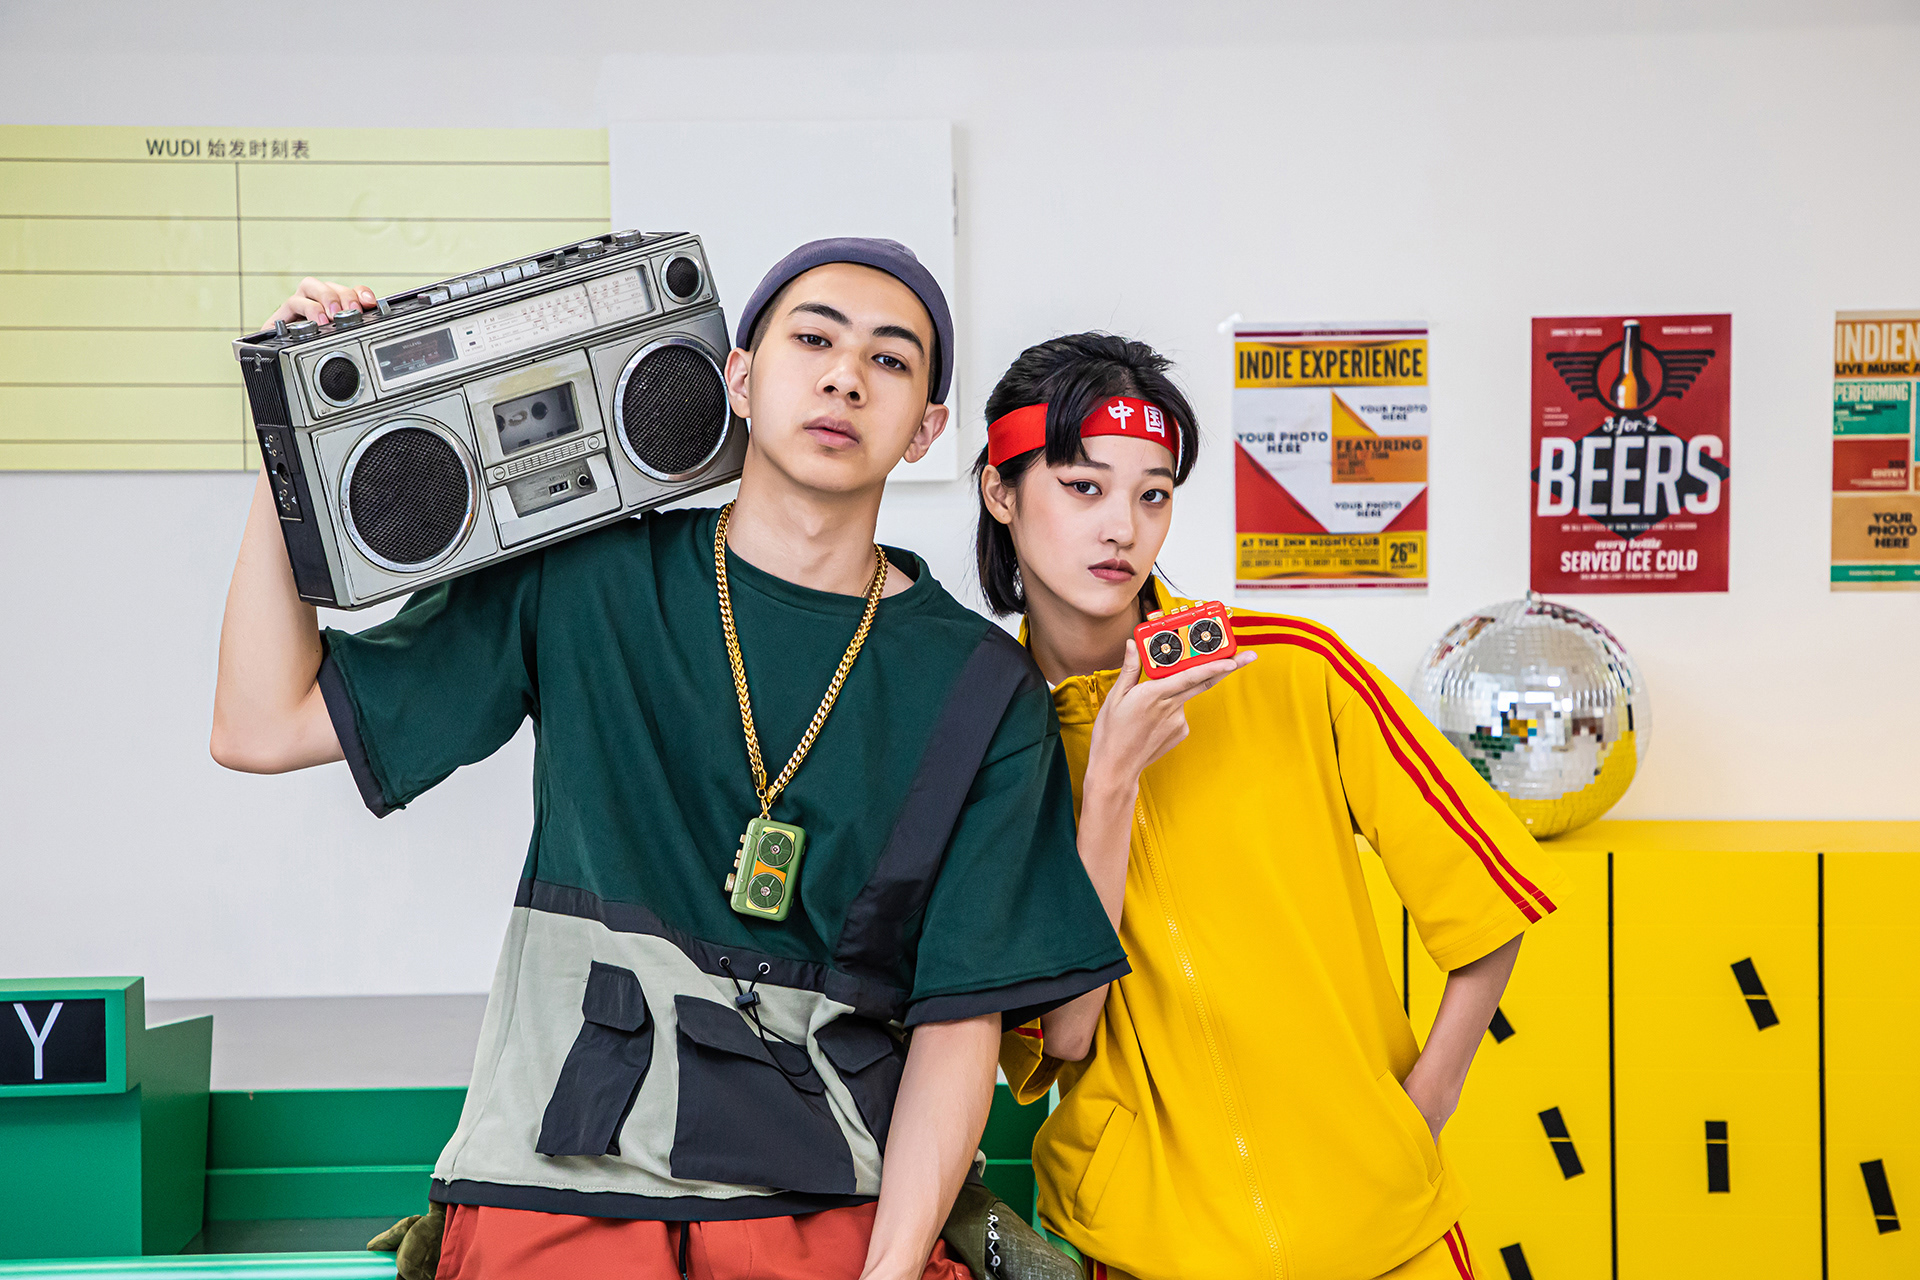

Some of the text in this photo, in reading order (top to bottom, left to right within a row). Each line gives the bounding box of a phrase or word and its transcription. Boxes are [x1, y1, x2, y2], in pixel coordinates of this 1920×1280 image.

[146, 138, 310, 159] WUDI 始发时刻表
[1239, 348, 1423, 380] INDIE EXPERIENCE
[1835, 362, 1864, 375] LIVE
[1867, 362, 1910, 375] MUSIC
[1834, 383, 1909, 403] PERFORMING
[1360, 403, 1428, 414] YOUR PHOTO
[1238, 431, 1329, 443] YOUR PHOTO
[1266, 442, 1301, 454] HERE
[1336, 438, 1423, 452] FEATURING
[1537, 434, 1723, 517] BEERS
[1334, 500, 1402, 510] YOUR PHOTO
[1356, 509, 1382, 518] HERE
[1874, 512, 1913, 524] YOUR
[1867, 524, 1918, 537] PHOTO
[1241, 539, 1254, 548] AT
[1258, 538, 1279, 547] THE
[1310, 536, 1380, 548] NIGHTCLUB
[1875, 537, 1909, 549] HERE
[1389, 541, 1418, 564] 26TH
[1560, 549, 1698, 573] SERVED ICE COLD
[12, 1002, 64, 1081] Y
